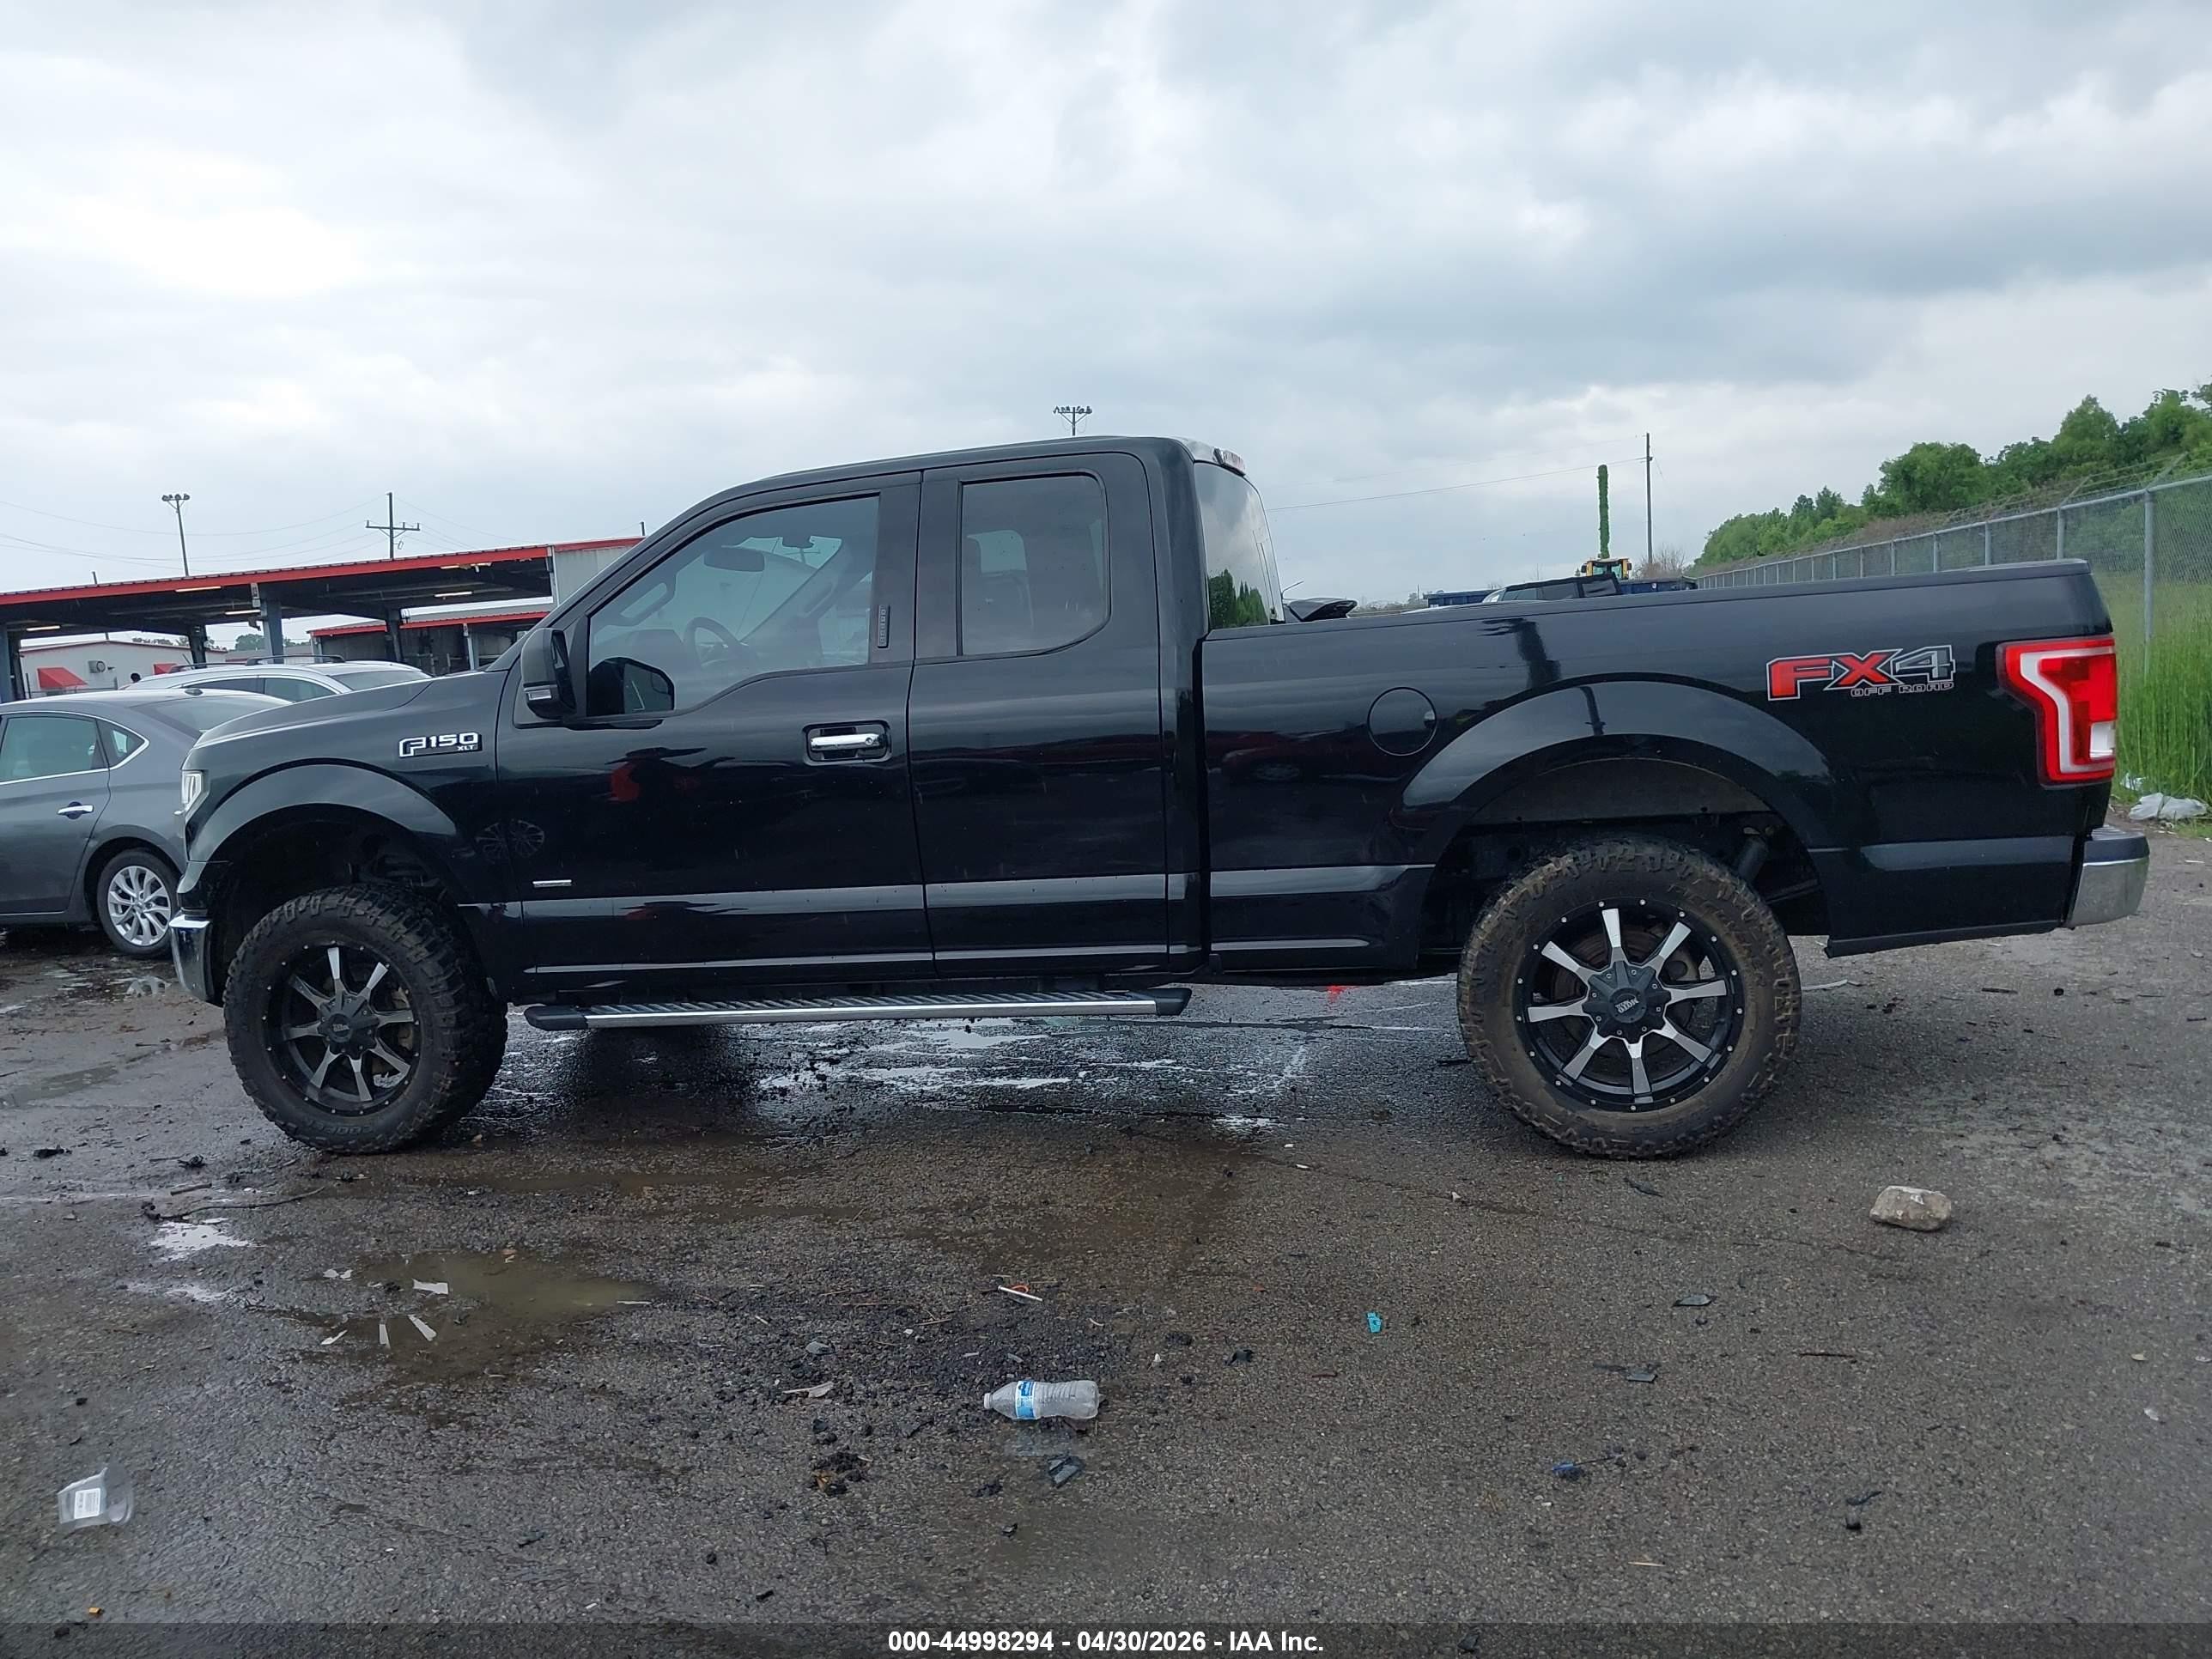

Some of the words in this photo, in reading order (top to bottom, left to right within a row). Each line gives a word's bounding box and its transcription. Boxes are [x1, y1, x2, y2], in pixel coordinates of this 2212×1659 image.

[1765, 644, 1956, 702] FX4
[1850, 686, 1892, 698] OFF
[1898, 680, 1955, 694] ROAD
